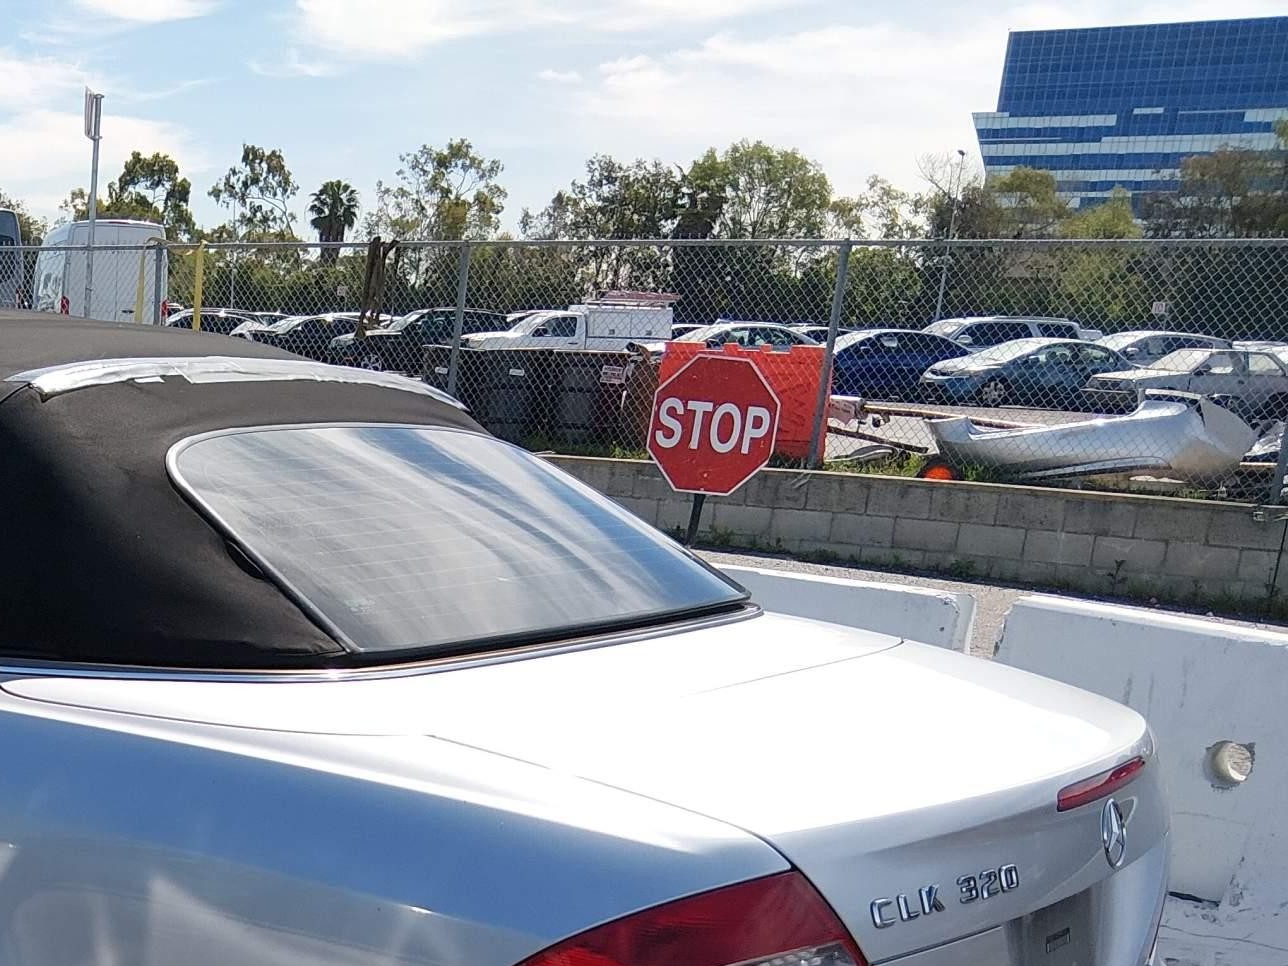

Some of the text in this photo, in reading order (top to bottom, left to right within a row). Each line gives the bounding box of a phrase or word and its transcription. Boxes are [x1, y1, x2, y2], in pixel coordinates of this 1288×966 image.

[655, 397, 771, 455] STOP
[870, 863, 1019, 930] CLK 320
